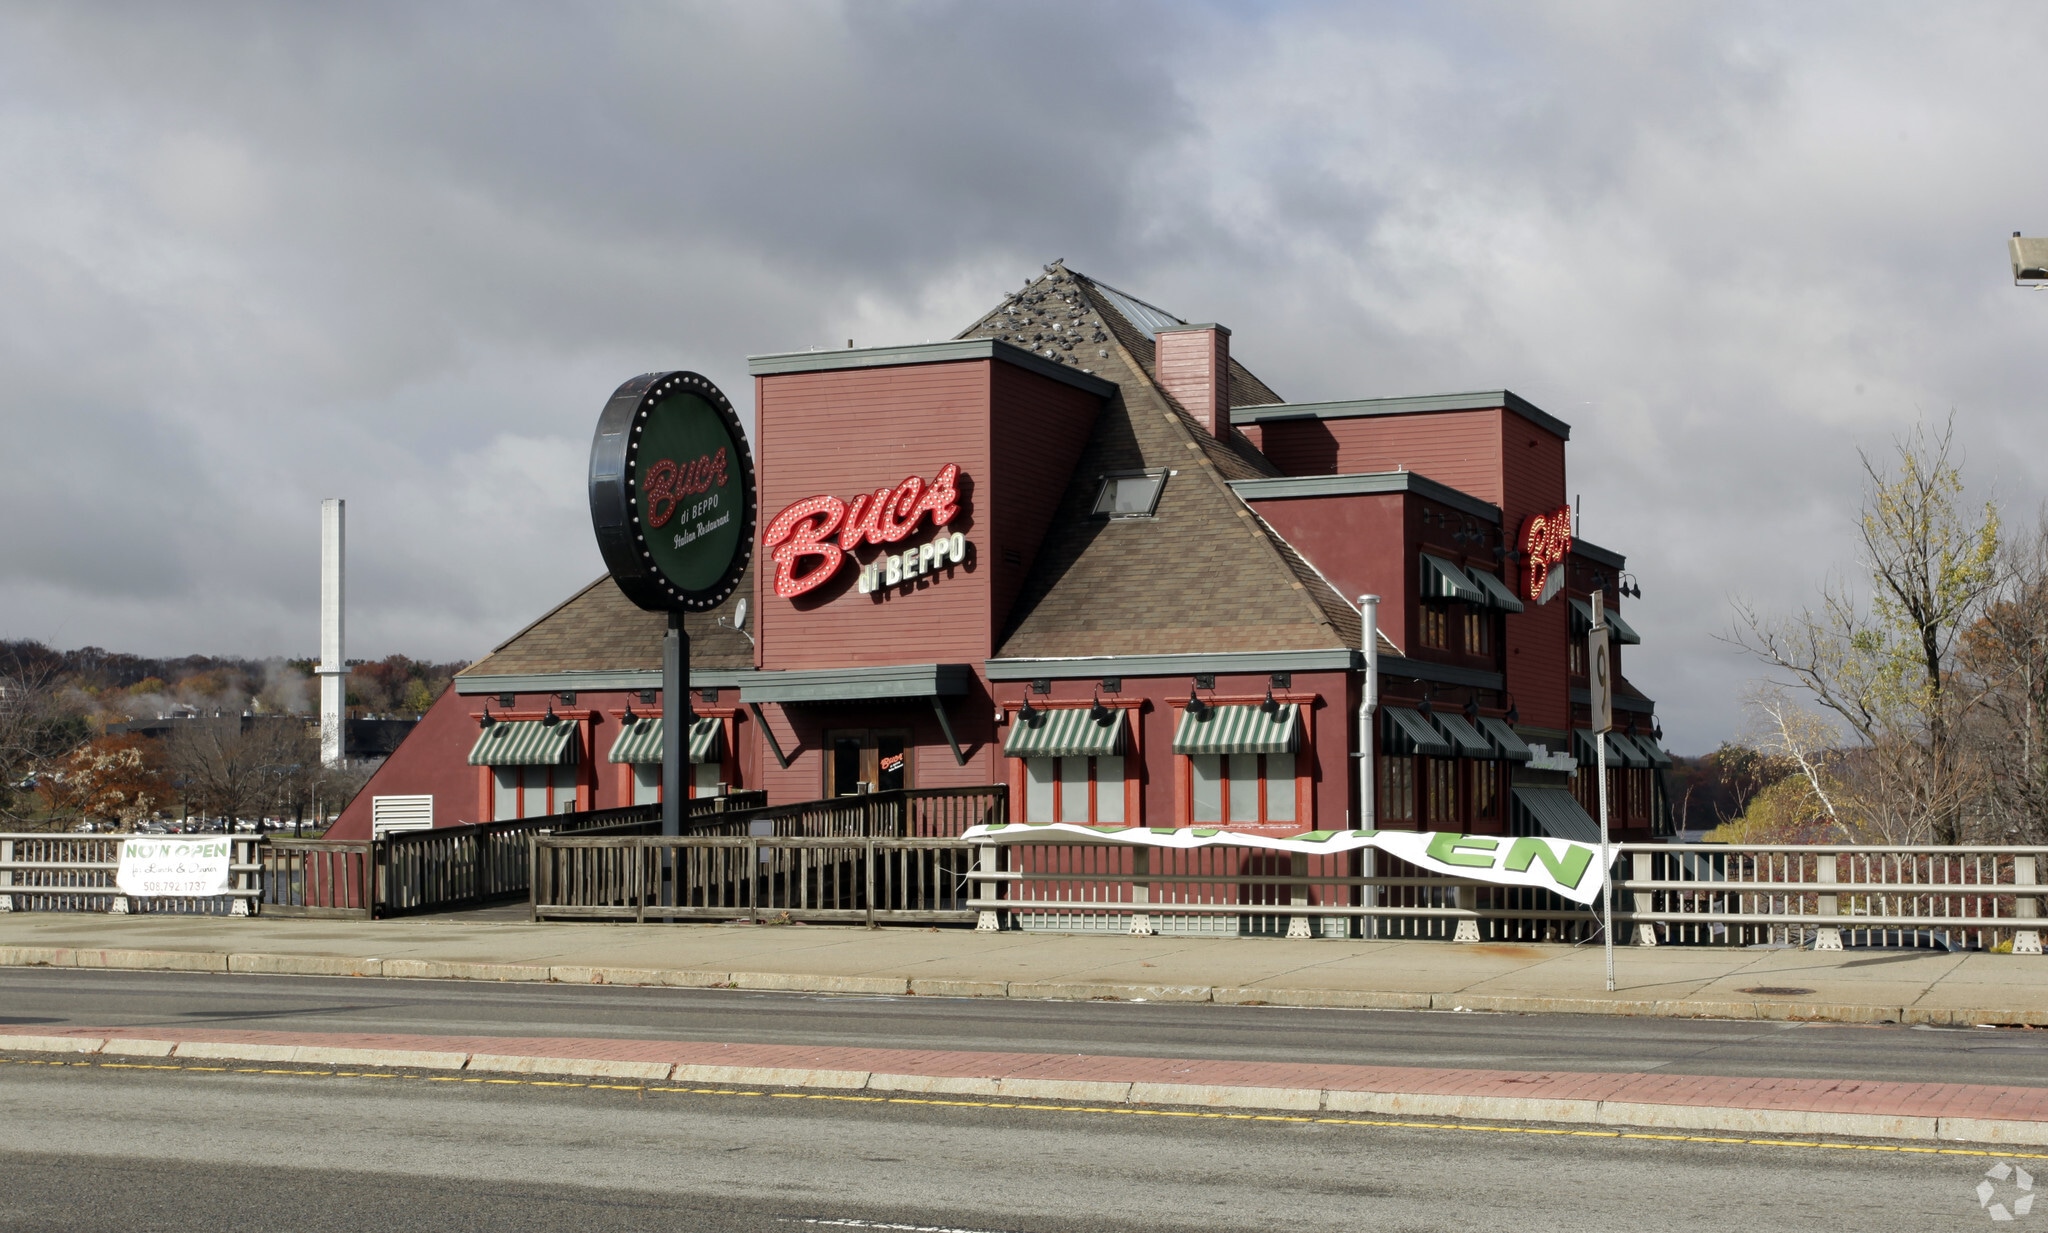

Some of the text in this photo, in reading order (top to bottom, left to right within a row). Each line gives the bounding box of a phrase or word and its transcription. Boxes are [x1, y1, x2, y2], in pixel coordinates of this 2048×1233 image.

[642, 446, 728, 528] BUCA
[680, 494, 719, 525] di BEPPO
[673, 510, 729, 550] Italian Restaurant
[763, 463, 961, 598] BUCA
[859, 532, 966, 594] di BEPPO
[175, 843, 227, 858] OPEN
[176, 862, 186, 874] &
